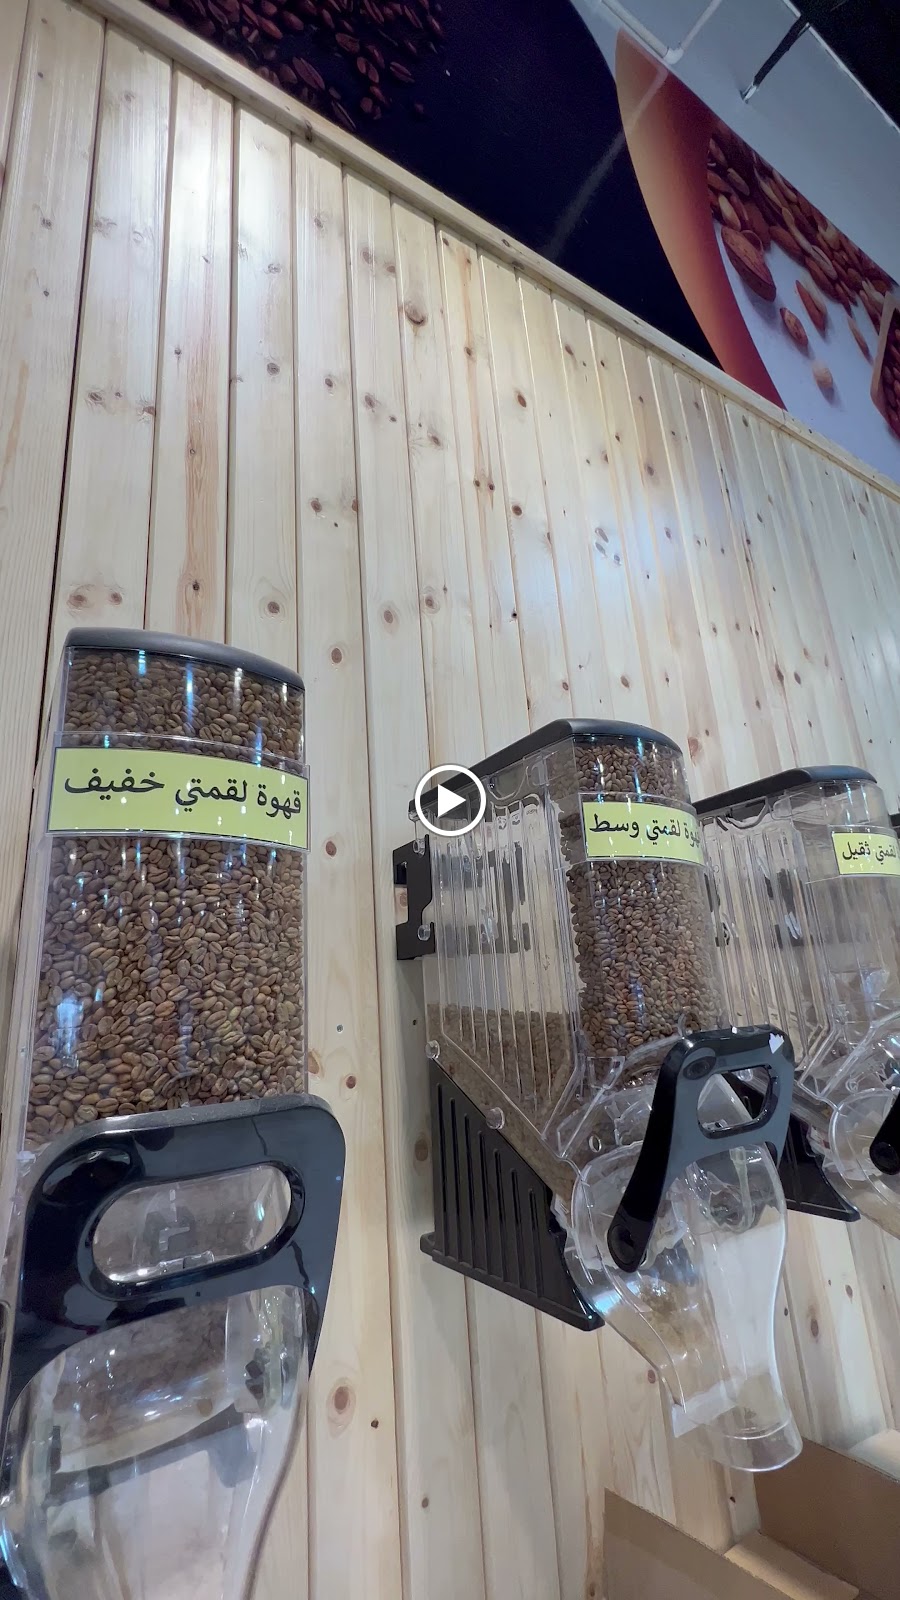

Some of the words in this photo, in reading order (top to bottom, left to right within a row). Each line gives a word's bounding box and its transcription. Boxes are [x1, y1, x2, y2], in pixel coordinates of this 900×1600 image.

[64, 768, 165, 800] خفيف
[175, 778, 247, 812] لقمتي
[256, 783, 302, 819] قهوة
[589, 813, 640, 838] وسط
[646, 819, 681, 845] لقمتي
[842, 841, 871, 860] ثقيل
